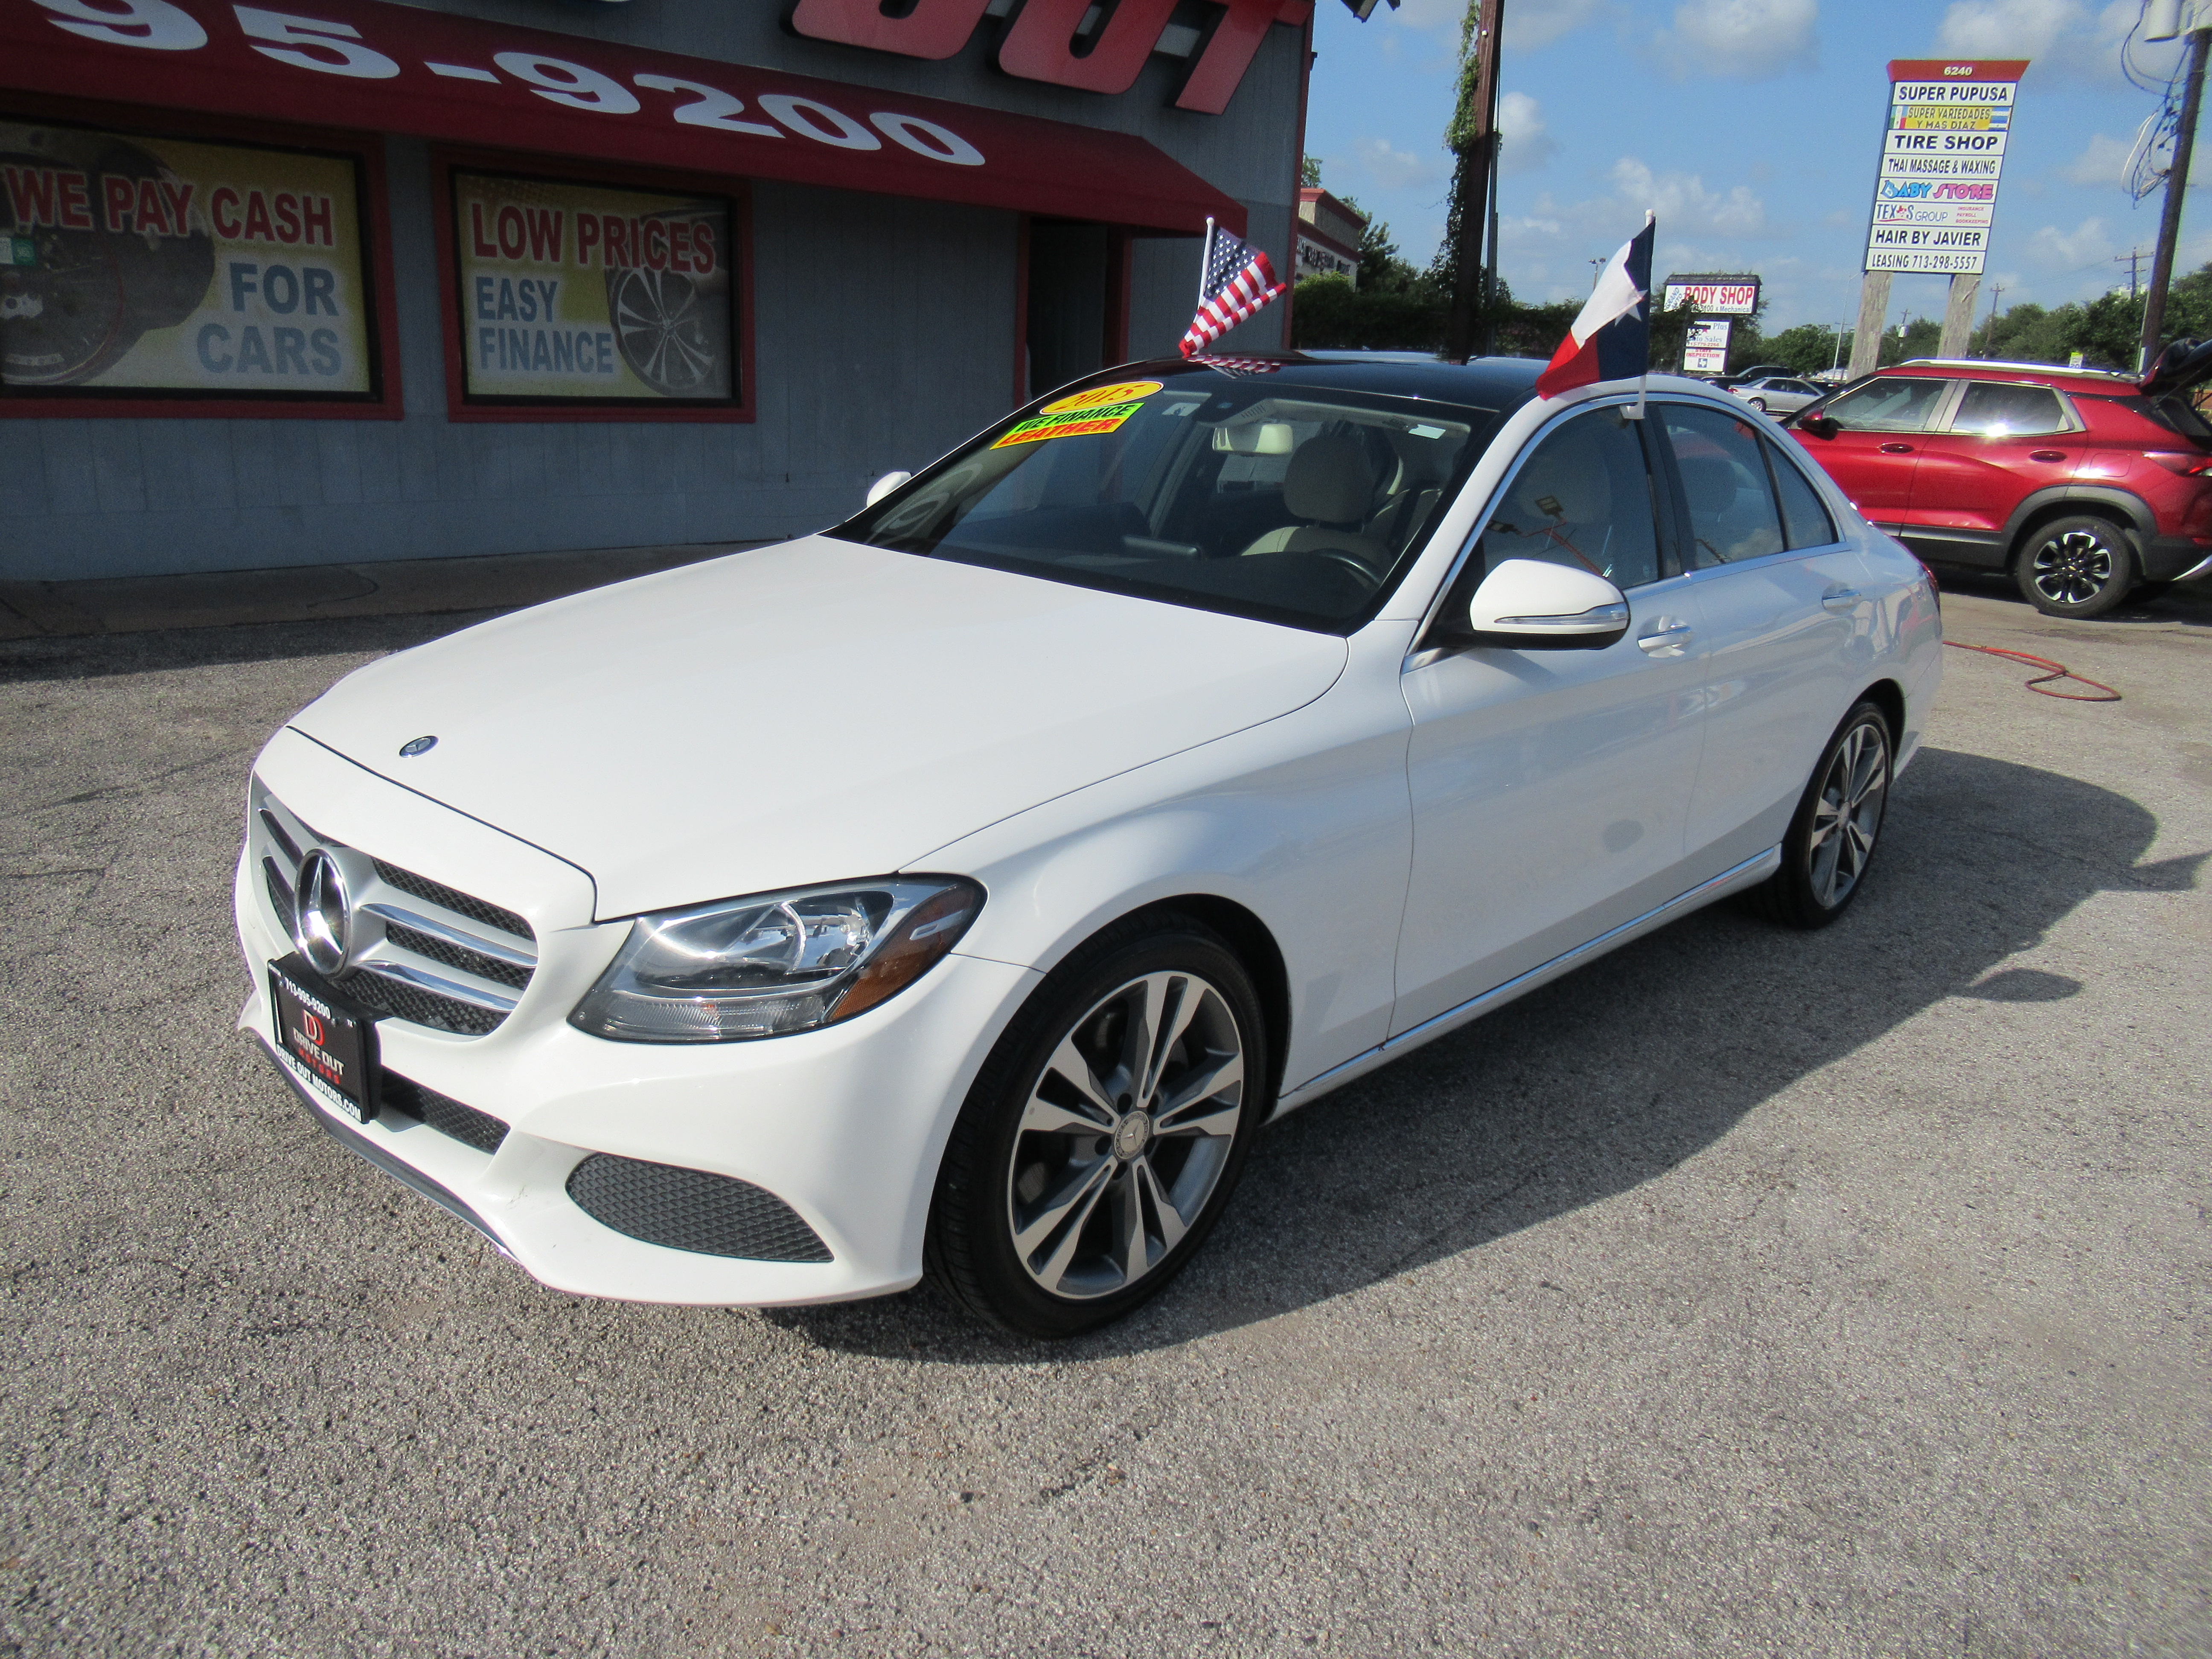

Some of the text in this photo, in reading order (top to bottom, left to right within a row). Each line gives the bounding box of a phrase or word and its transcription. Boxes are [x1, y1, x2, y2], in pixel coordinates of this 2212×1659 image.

[1944, 67, 1973, 76] 6240
[1899, 86, 2008, 102] SUPER PUPUSA
[1908, 107, 1991, 119] SUPER VARIEDADES
[1917, 120, 1976, 130] Y MAS DIAZ
[1895, 135, 1998, 150] TIRE SHOP
[1888, 158, 1996, 174] THAI MASSAGE & WAXING
[1881, 180, 1994, 200] BABY STORE
[6, 169, 334, 246] WE PAY CASH
[1915, 211, 1948, 222] GROUP
[472, 203, 715, 274] LOW PRICES
[1875, 230, 1981, 246] HAIR BY JAVIER
[1871, 254, 1977, 269] LEASING 713-298-5557
[229, 262, 339, 317] FOR
[476, 276, 559, 323] EASY
[1720, 286, 1753, 305] SHOP
[197, 323, 341, 376] CARS
[478, 327, 613, 373] FINANCE
[1044, 405, 1138, 426] FINANCE
[998, 418, 1122, 446] LEATHER
[293, 1027, 345, 1075] DRIVE OUT
[277, 1044, 297, 1070] DRIVE
[297, 1061, 311, 1082] OUT
